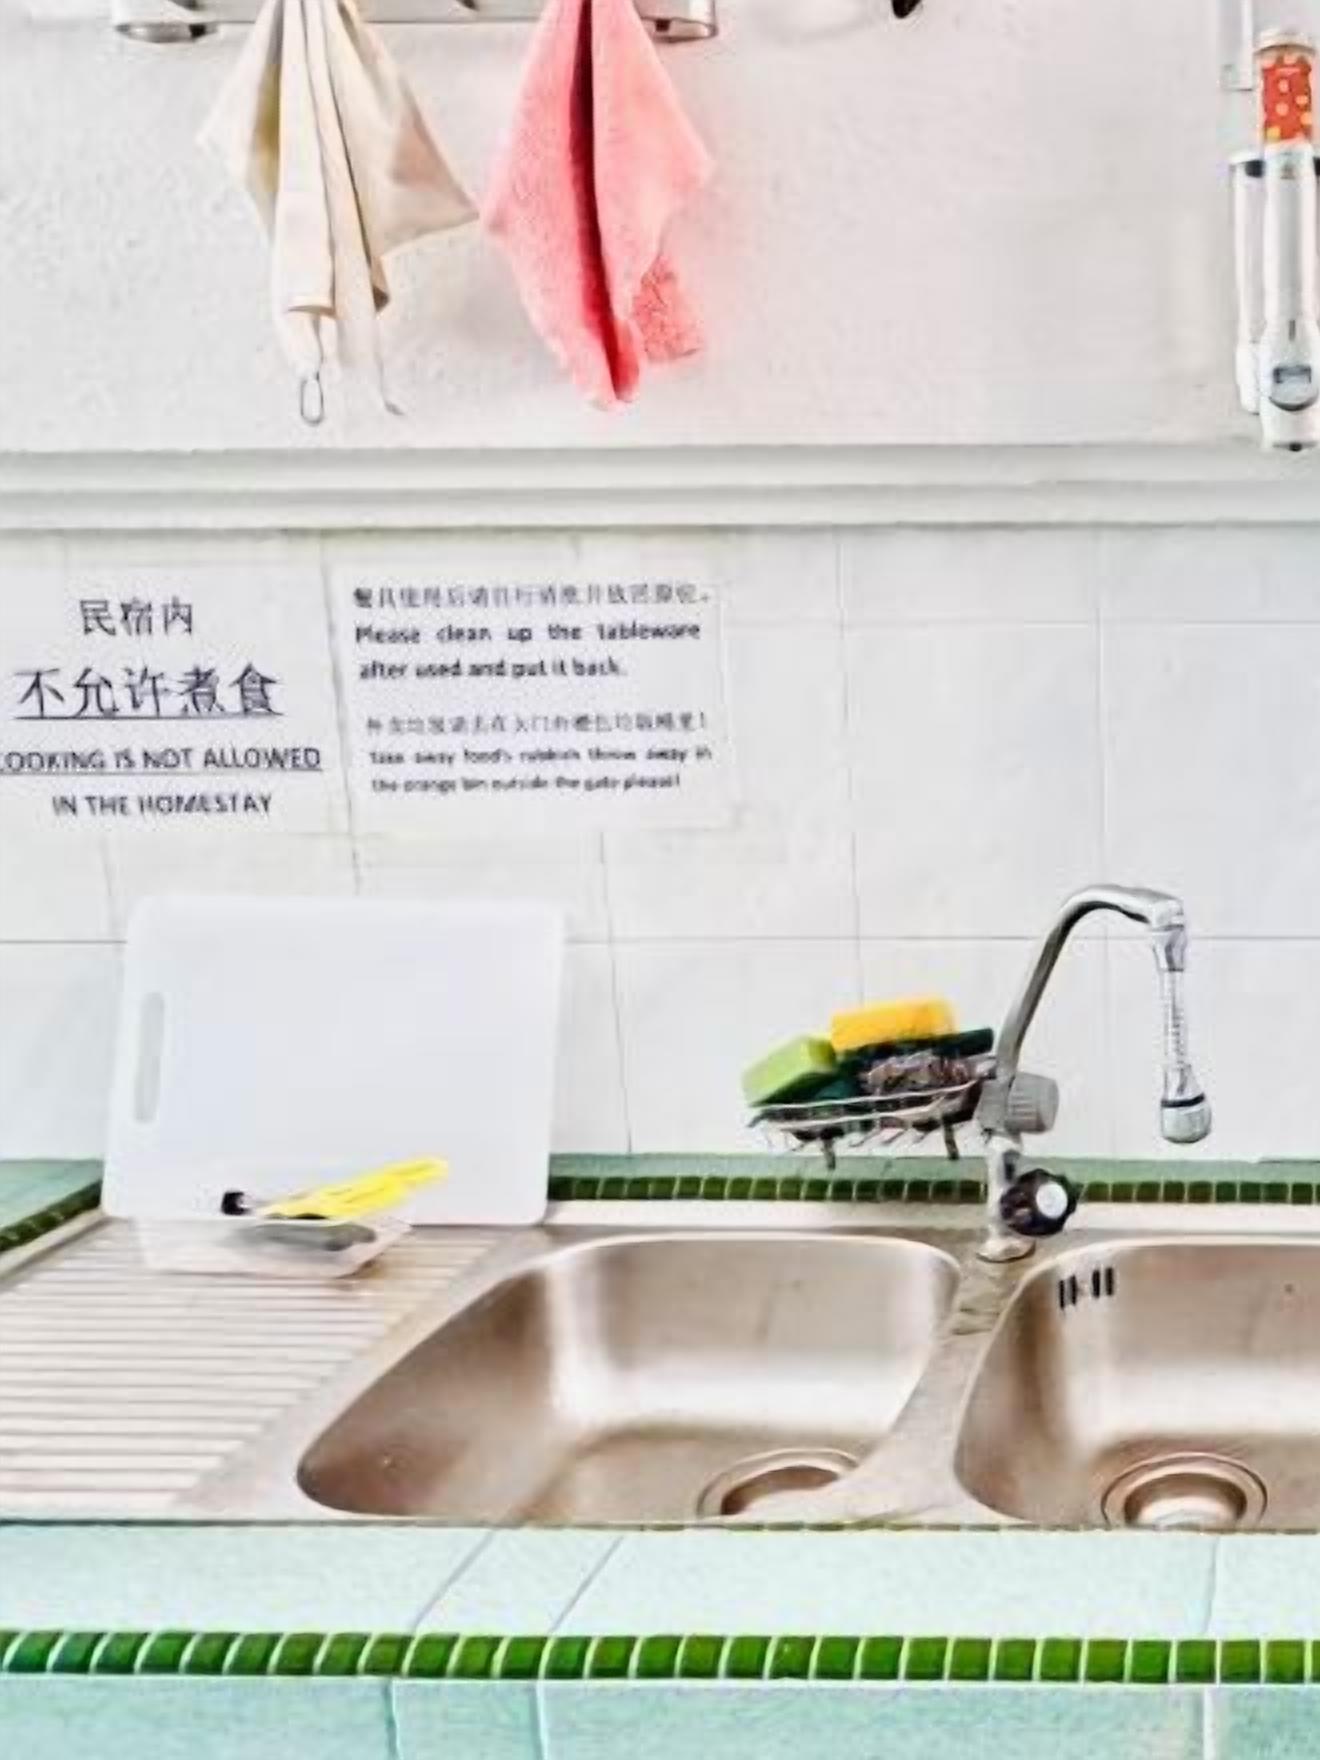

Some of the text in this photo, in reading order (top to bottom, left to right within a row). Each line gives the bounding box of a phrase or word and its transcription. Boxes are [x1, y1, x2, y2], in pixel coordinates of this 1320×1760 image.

[356, 618, 702, 644] Please clean up the tableware
[361, 660, 407, 679] after
[415, 658, 462, 678] used
[468, 658, 507, 677] and
[511, 659, 547, 679] put
[551, 656, 568, 678] it
[14, 661, 285, 720] 不允许煮食
[0, 746, 321, 772] OOKING IS NOT ALLOWED
[52, 793, 272, 816] IN THE HOMESTAY
